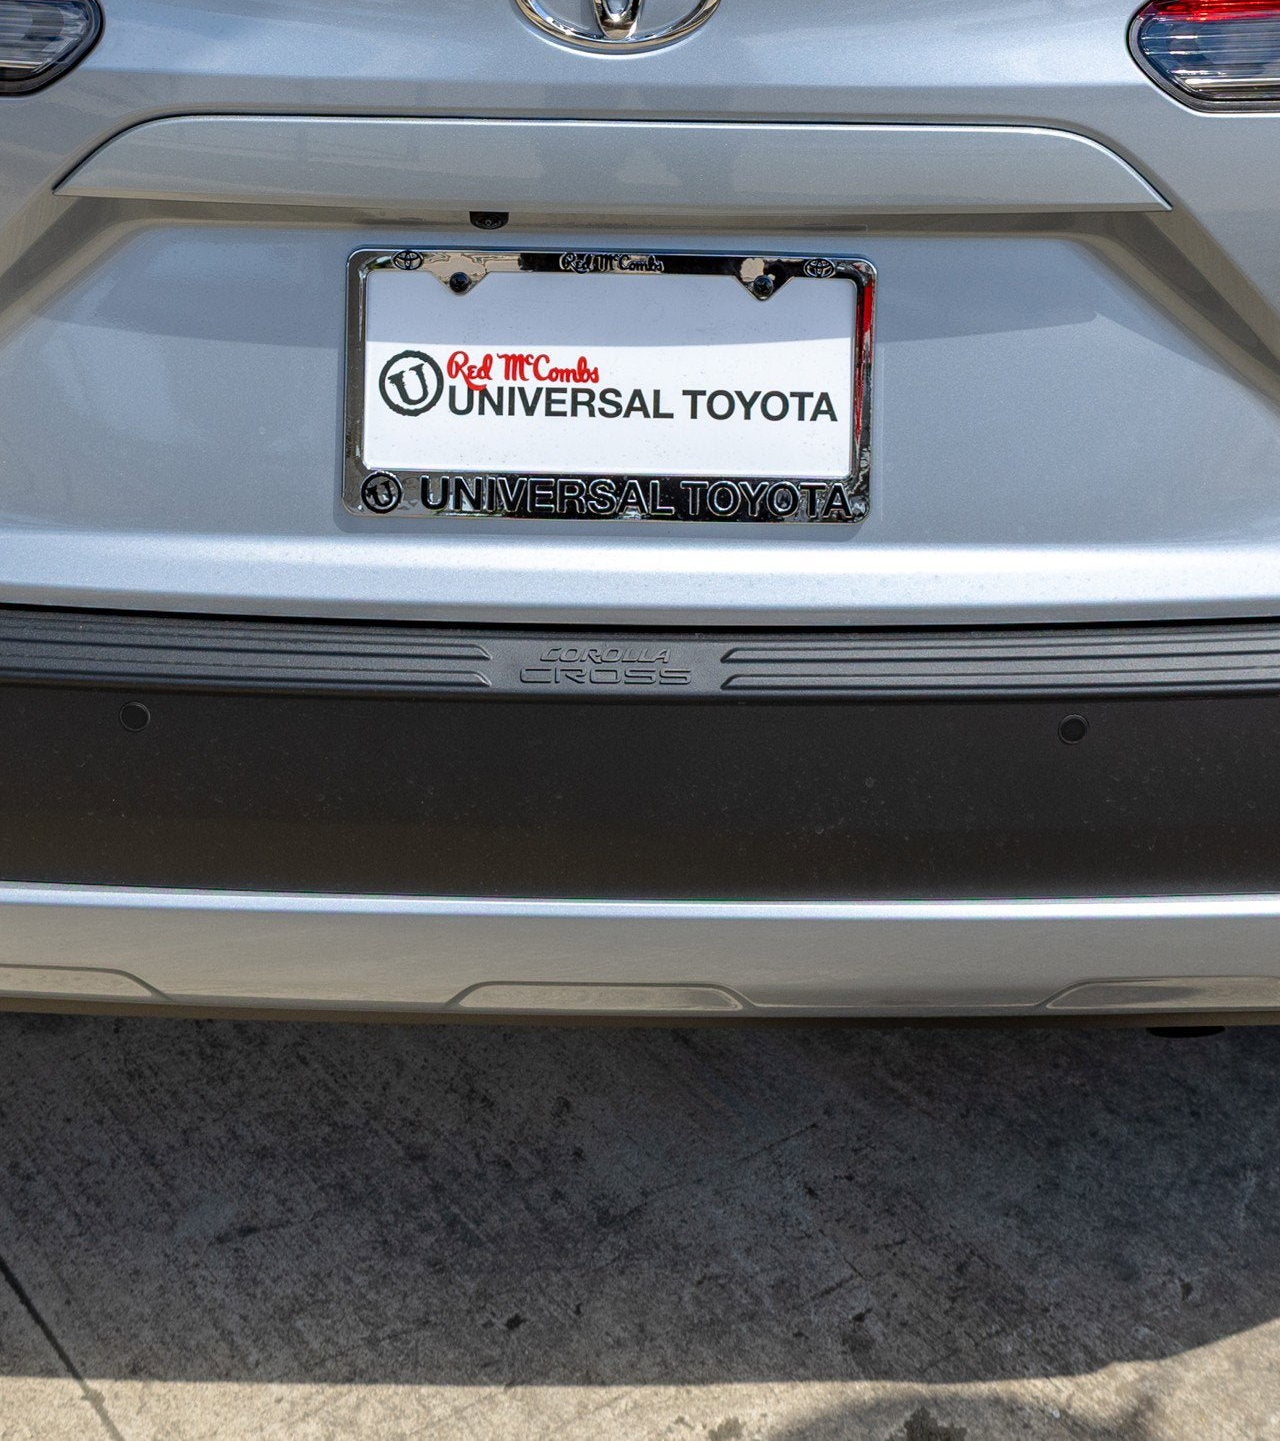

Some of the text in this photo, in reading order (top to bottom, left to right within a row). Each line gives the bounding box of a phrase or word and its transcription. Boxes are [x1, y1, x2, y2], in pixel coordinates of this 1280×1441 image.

[447, 350, 600, 391] Red McCombs
[448, 385, 838, 422] UNIVERSAL TOYOTA
[419, 475, 853, 519] UNIVERSAL TOYOTA
[539, 647, 671, 664] COROLLA
[520, 666, 692, 686] CROSS
